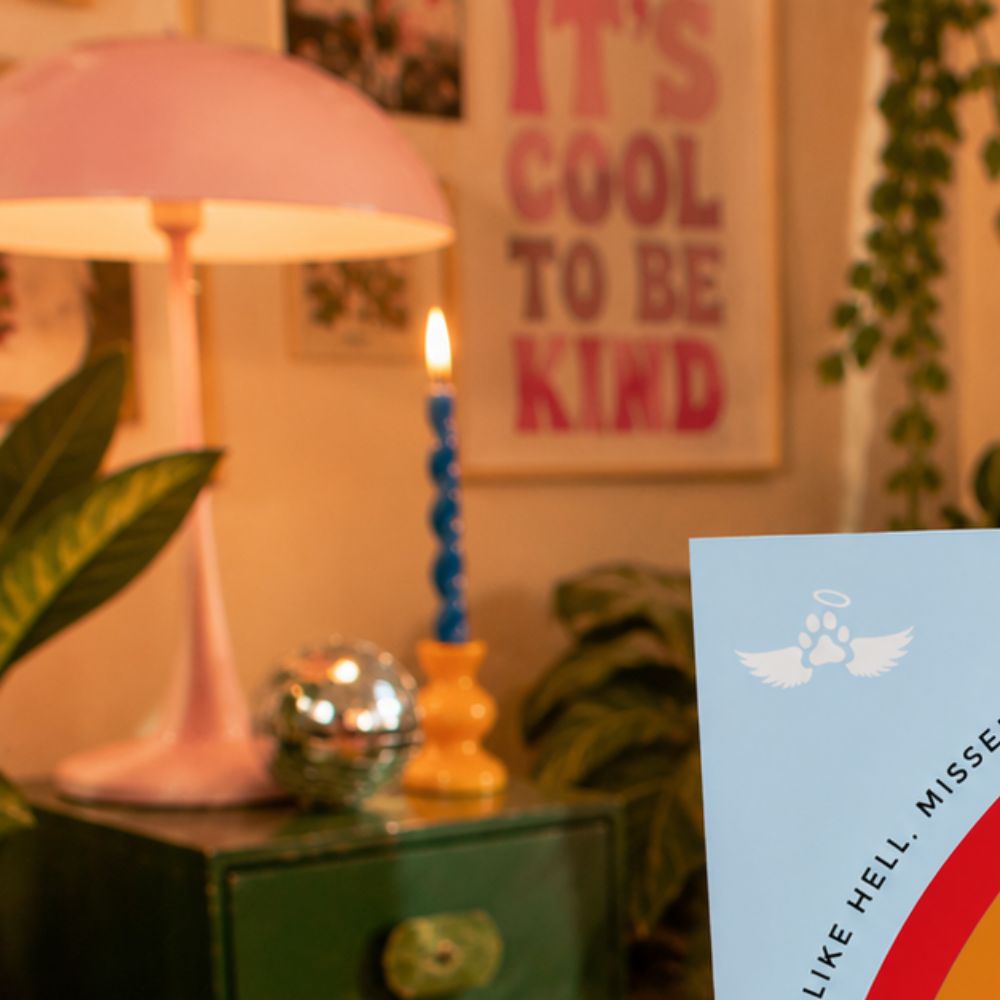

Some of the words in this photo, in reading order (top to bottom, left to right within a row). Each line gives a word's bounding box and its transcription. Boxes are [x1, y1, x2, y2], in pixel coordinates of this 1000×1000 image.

[508, 0, 721, 121] IT'S
[506, 128, 725, 229] COOL
[508, 238, 606, 323] TO
[635, 240, 725, 327] BE
[511, 334, 728, 435] KIND
[802, 923, 853, 999] LIKE
[847, 834, 919, 913] HELL.
